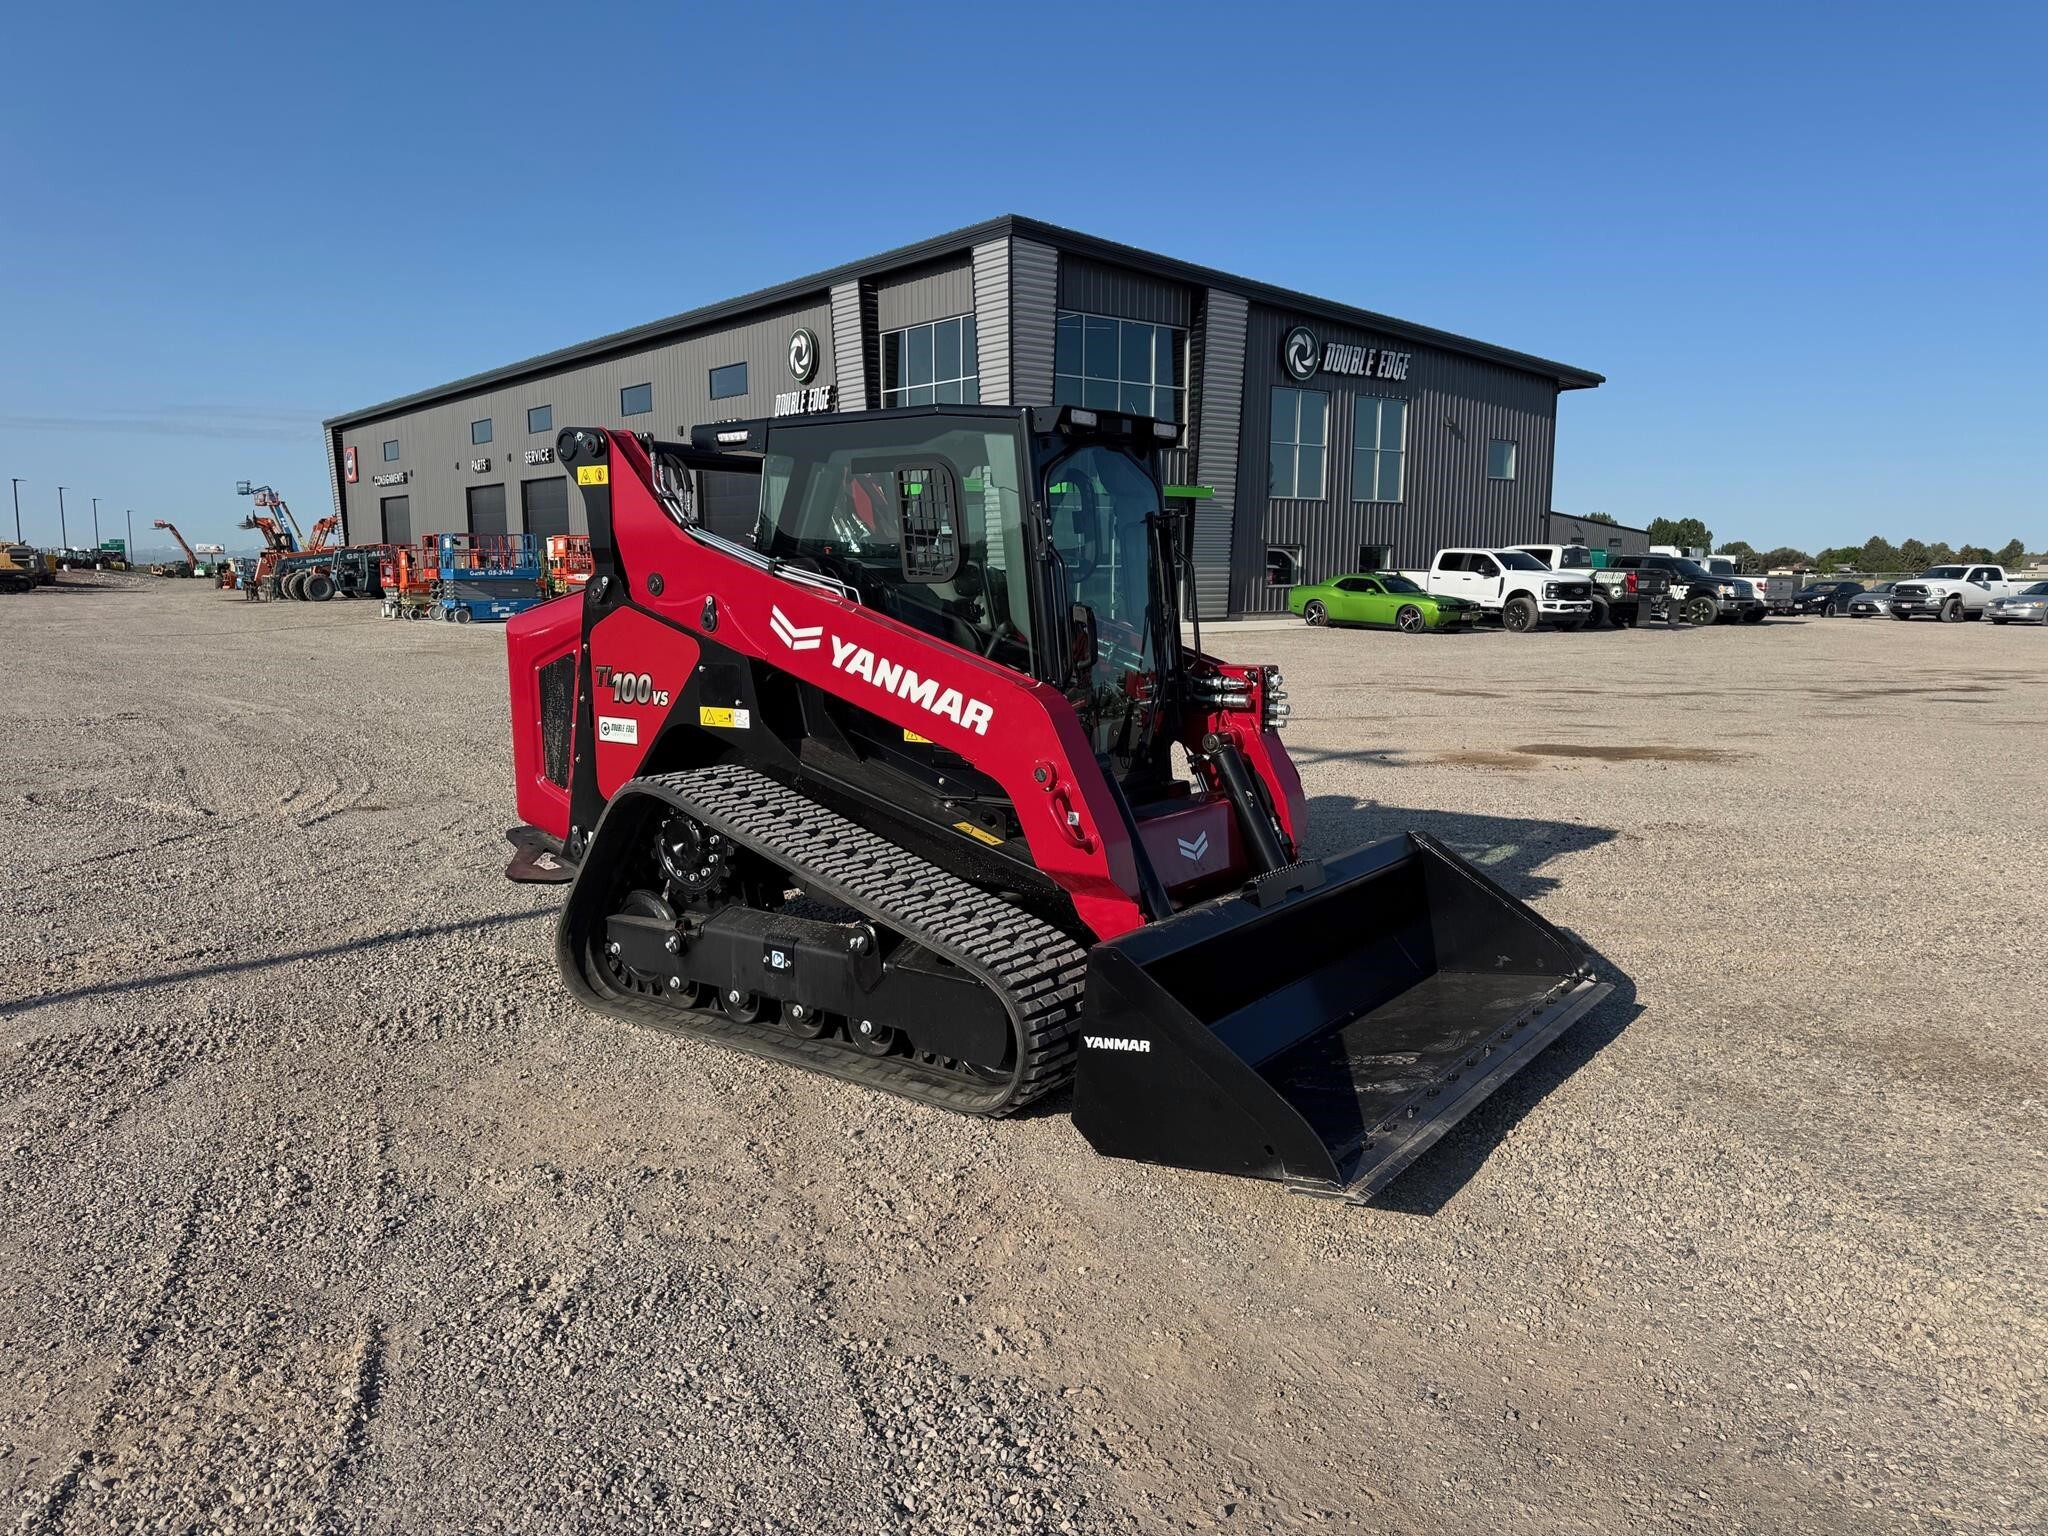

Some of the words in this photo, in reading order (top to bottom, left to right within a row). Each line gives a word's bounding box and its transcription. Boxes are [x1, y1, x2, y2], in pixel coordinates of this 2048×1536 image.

[1323, 342, 1377, 376] DOUBLE
[1377, 350, 1411, 381] EDGE
[775, 390, 805, 417] DOUBLE
[808, 386, 831, 412] EDGE
[525, 449, 550, 464] SERVICE
[471, 459, 487, 472] PARTS
[373, 472, 405, 487] CONSIGNMENTS
[831, 634, 994, 736] YANMAR
[1083, 1036, 1151, 1052] YANMAR
